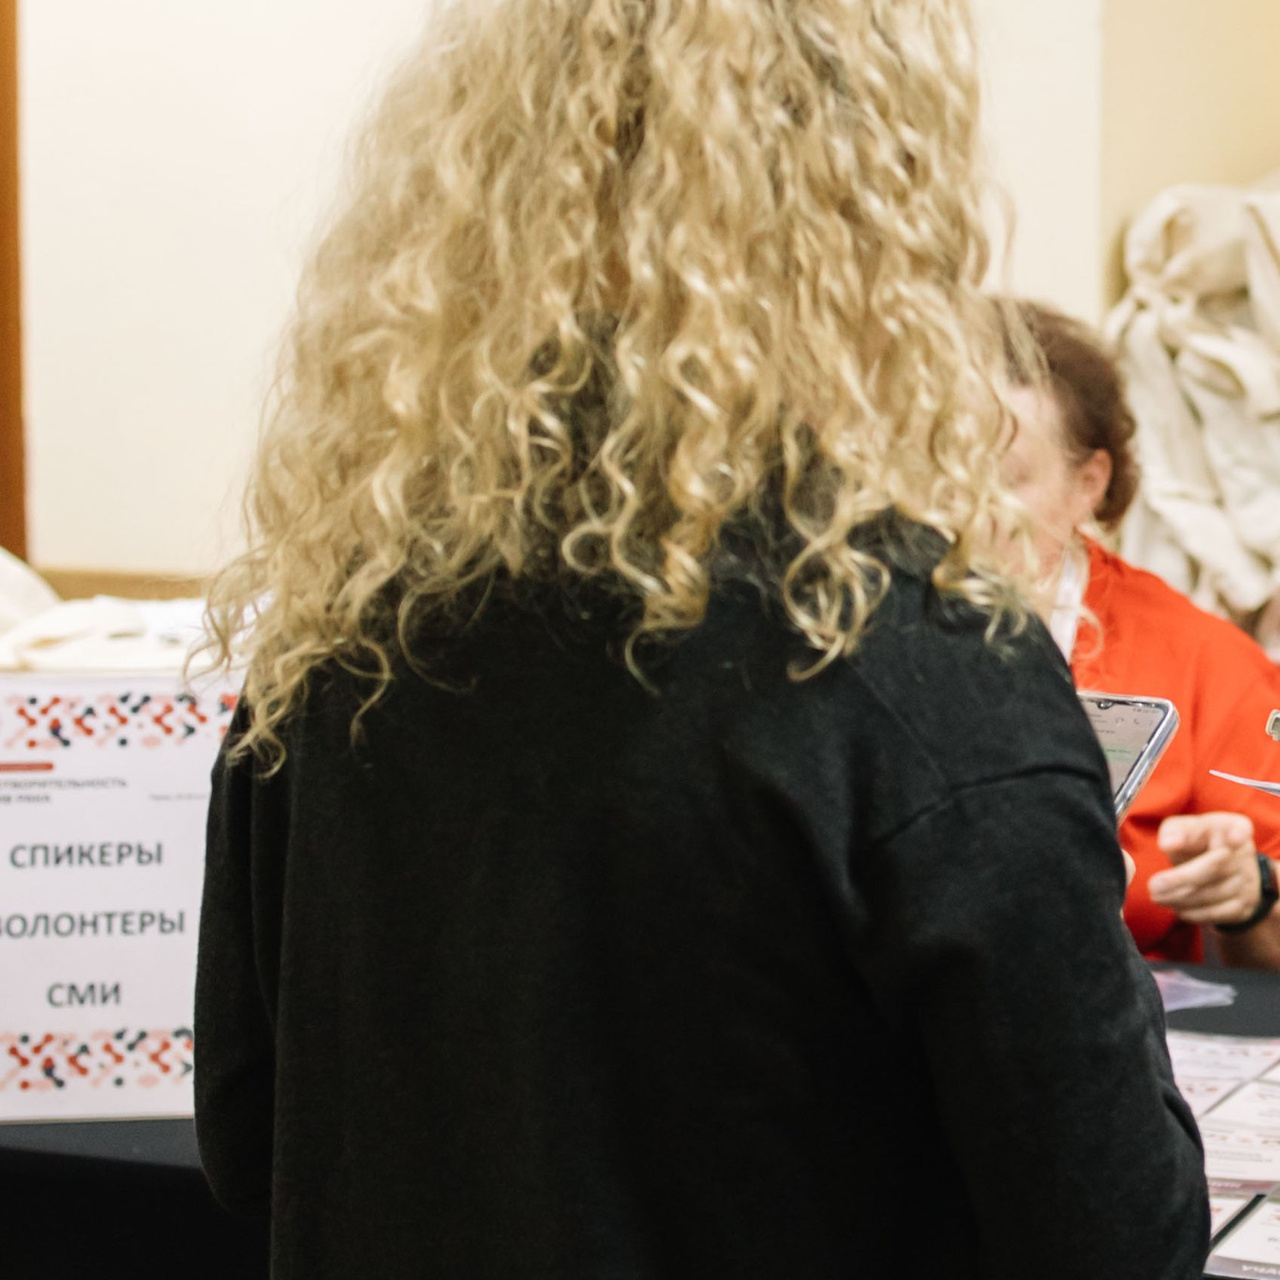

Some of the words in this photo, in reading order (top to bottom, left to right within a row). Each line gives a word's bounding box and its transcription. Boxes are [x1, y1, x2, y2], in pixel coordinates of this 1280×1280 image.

[9, 842, 163, 868] СПИКЕРЫ
[0, 911, 185, 939] ОЛОНТЕРЫ
[46, 981, 121, 1007] СМИ
